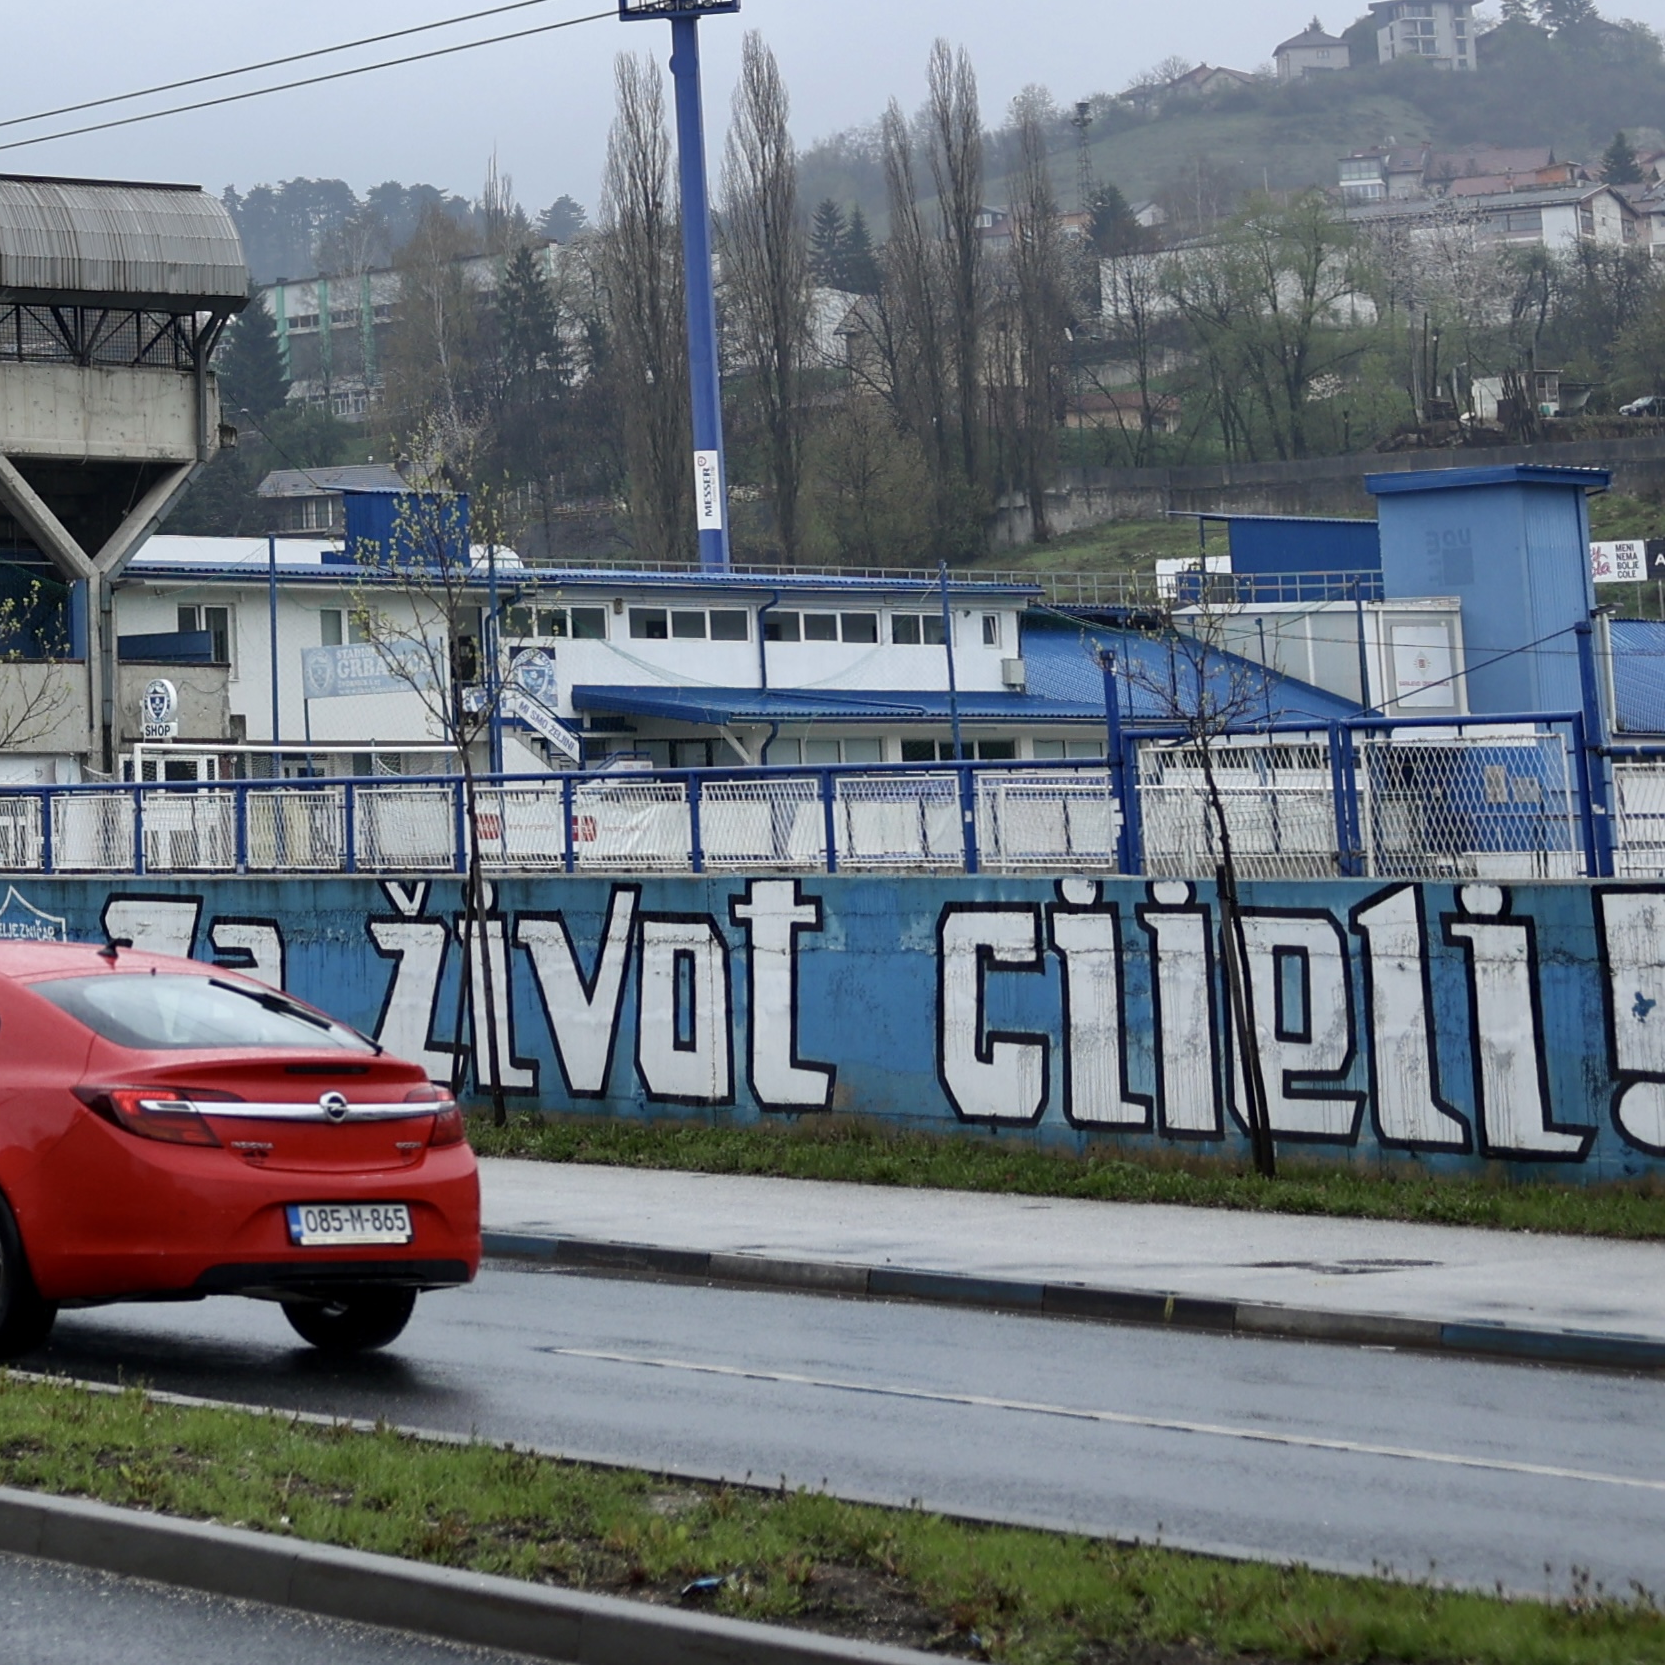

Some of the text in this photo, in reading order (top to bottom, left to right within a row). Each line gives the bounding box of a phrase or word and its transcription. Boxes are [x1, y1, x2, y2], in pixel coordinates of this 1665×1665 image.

[702, 467, 713, 517] MESSER
[1615, 543, 1635, 552] MENI
[1615, 552, 1638, 561] NEMA
[1616, 561, 1639, 570] BOLJE
[1617, 570, 1637, 579] COLE
[518, 701, 531, 715] MI
[530, 710, 549, 730] SMO
[144, 724, 171, 737] SHOP
